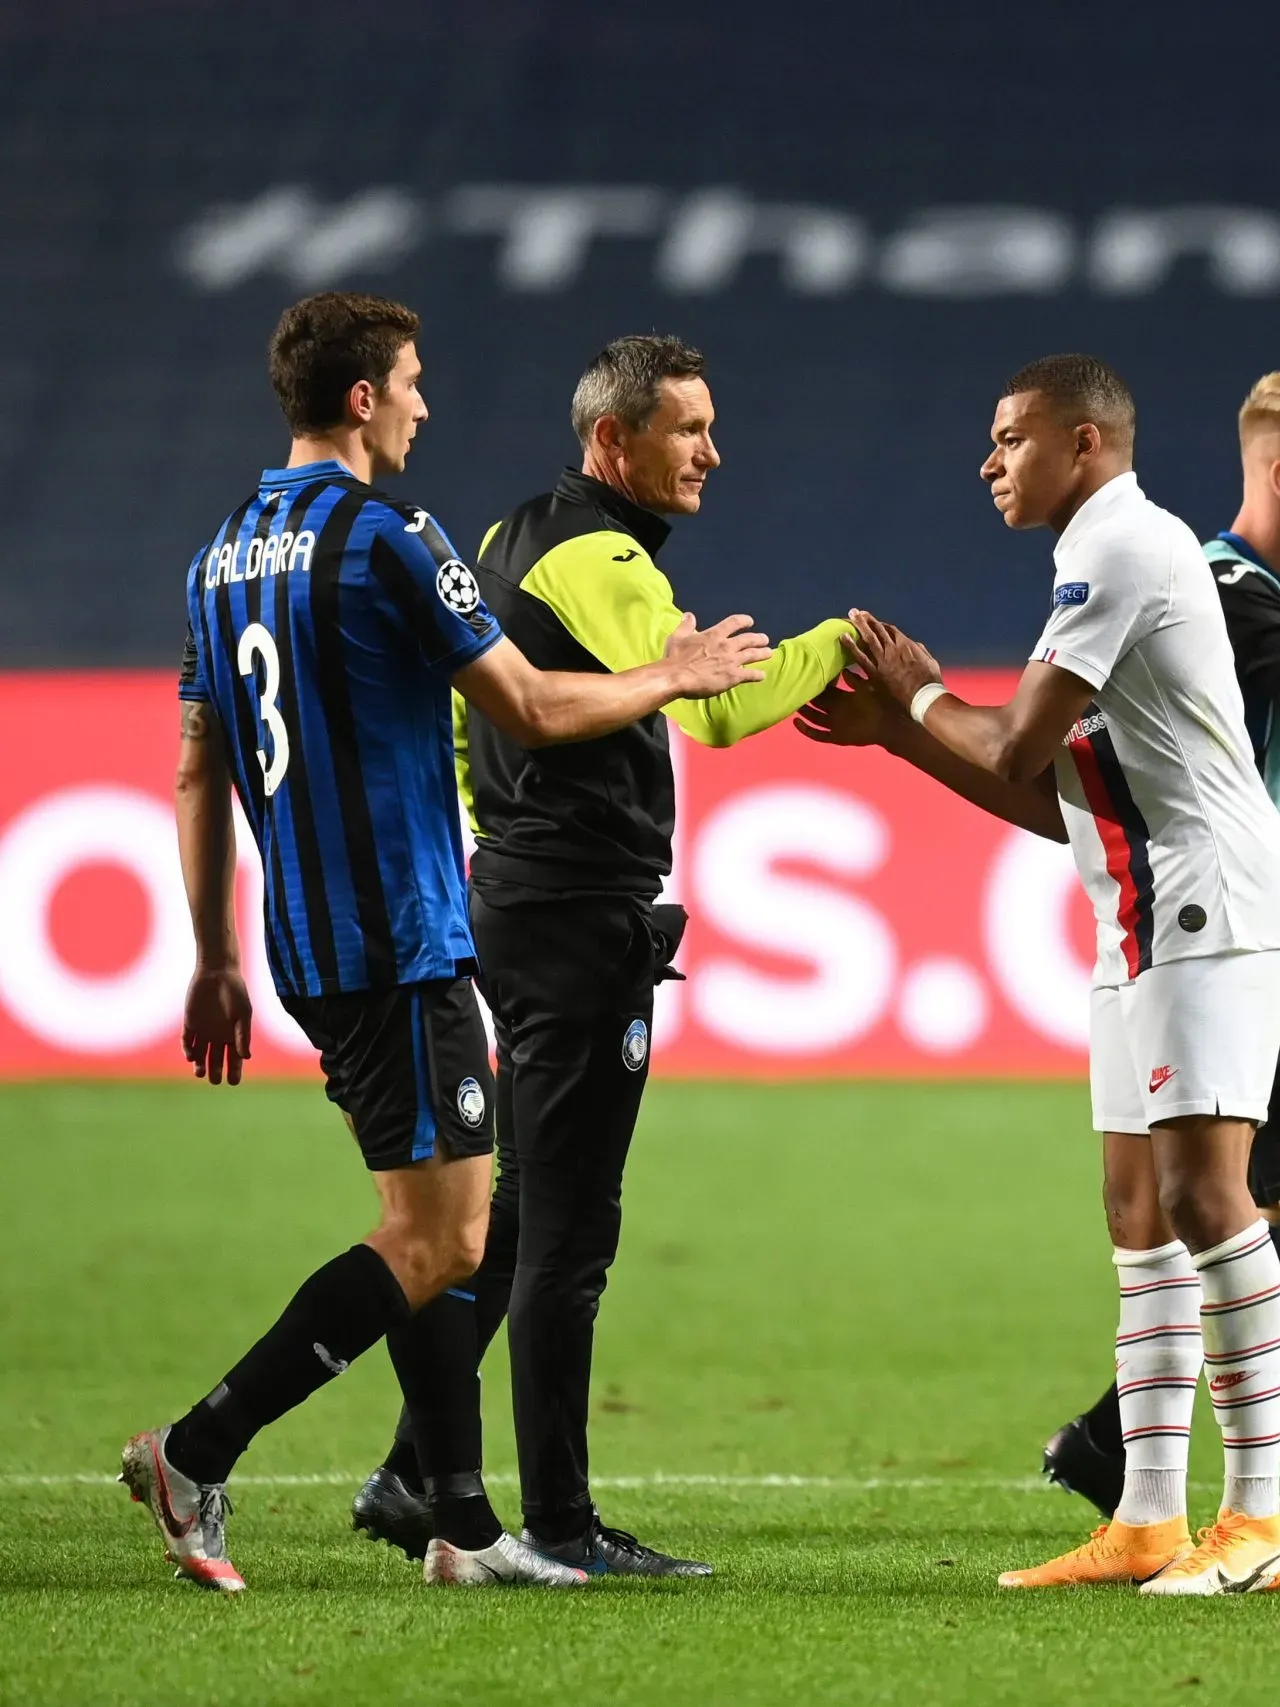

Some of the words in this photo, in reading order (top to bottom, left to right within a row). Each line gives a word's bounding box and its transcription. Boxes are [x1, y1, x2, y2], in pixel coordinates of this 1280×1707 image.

[205, 530, 316, 590] CALDARA
[237, 622, 290, 797] 3
[1151, 1064, 1171, 1082] NIKE
[1215, 1371, 1247, 1384] NIKE
